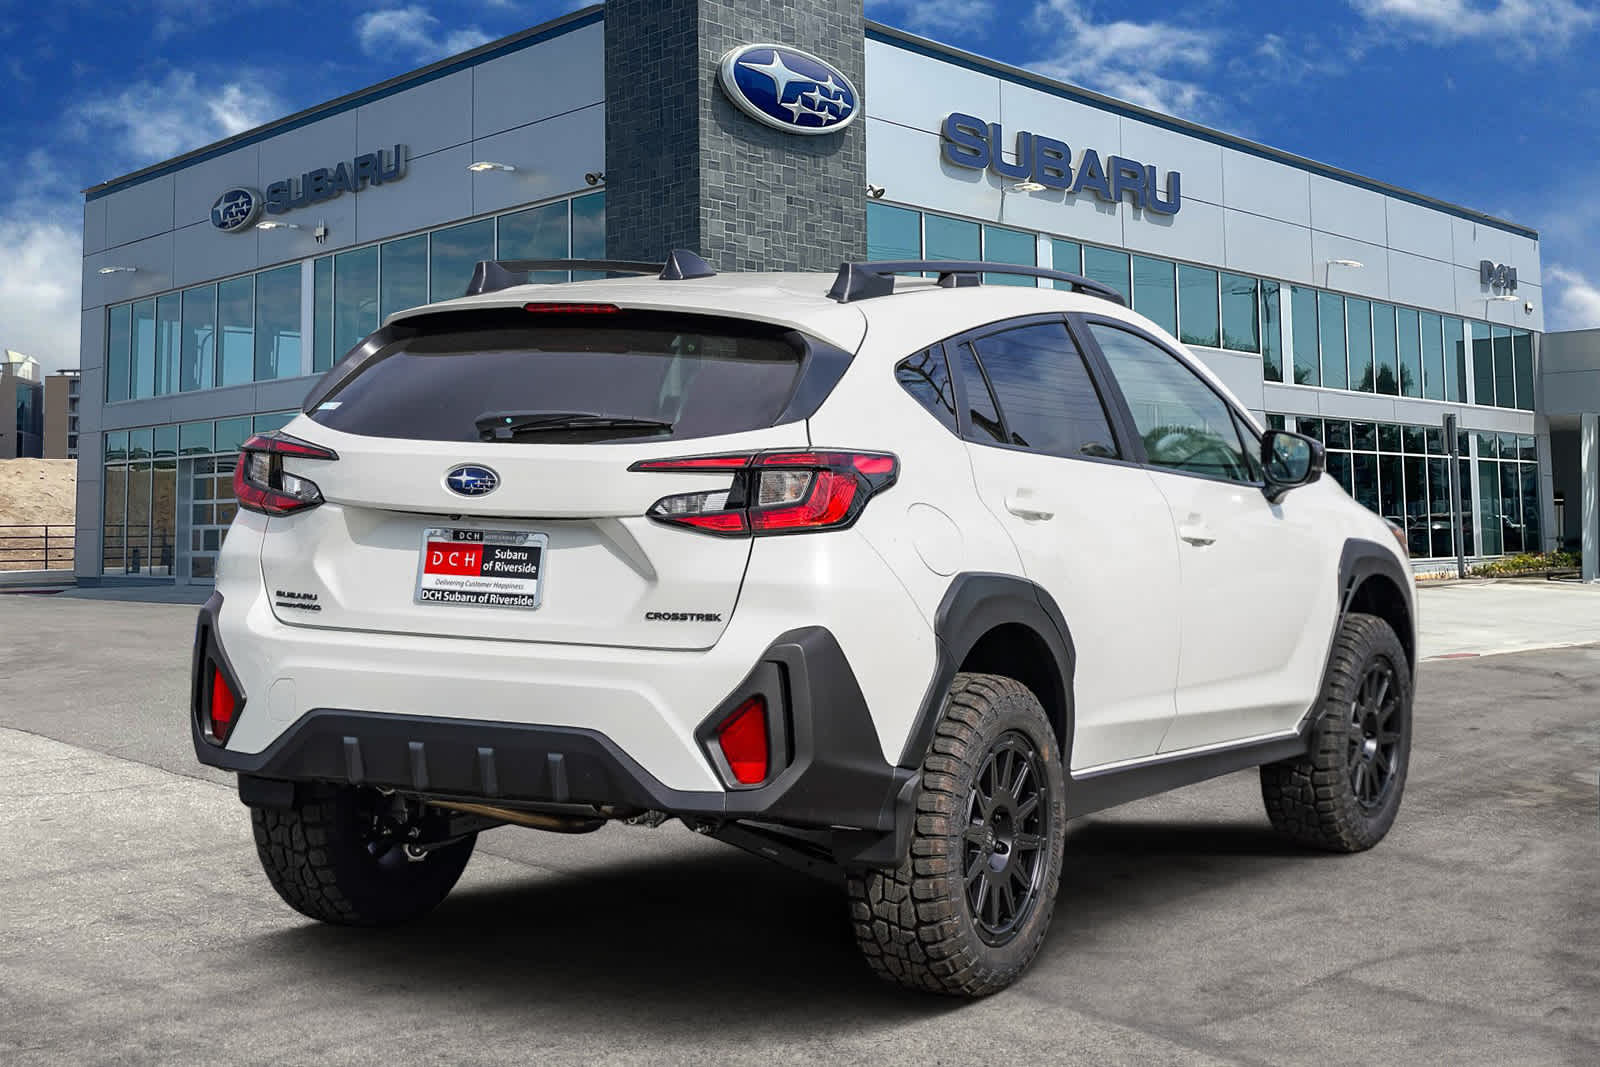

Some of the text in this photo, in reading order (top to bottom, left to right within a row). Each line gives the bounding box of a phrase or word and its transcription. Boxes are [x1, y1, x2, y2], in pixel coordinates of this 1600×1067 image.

[940, 112, 1181, 215] SUBARU
[265, 143, 402, 215] SUBARU
[458, 531, 481, 540] DCH
[432, 551, 476, 567] DCH
[494, 549, 528, 560] Subaru
[482, 561, 537, 574] of Riverside
[435, 578, 525, 590] Delivering Customer Happiness
[422, 590, 534, 607] DCH Subaru of Riverside
[645, 612, 722, 622] CROSSTREK
